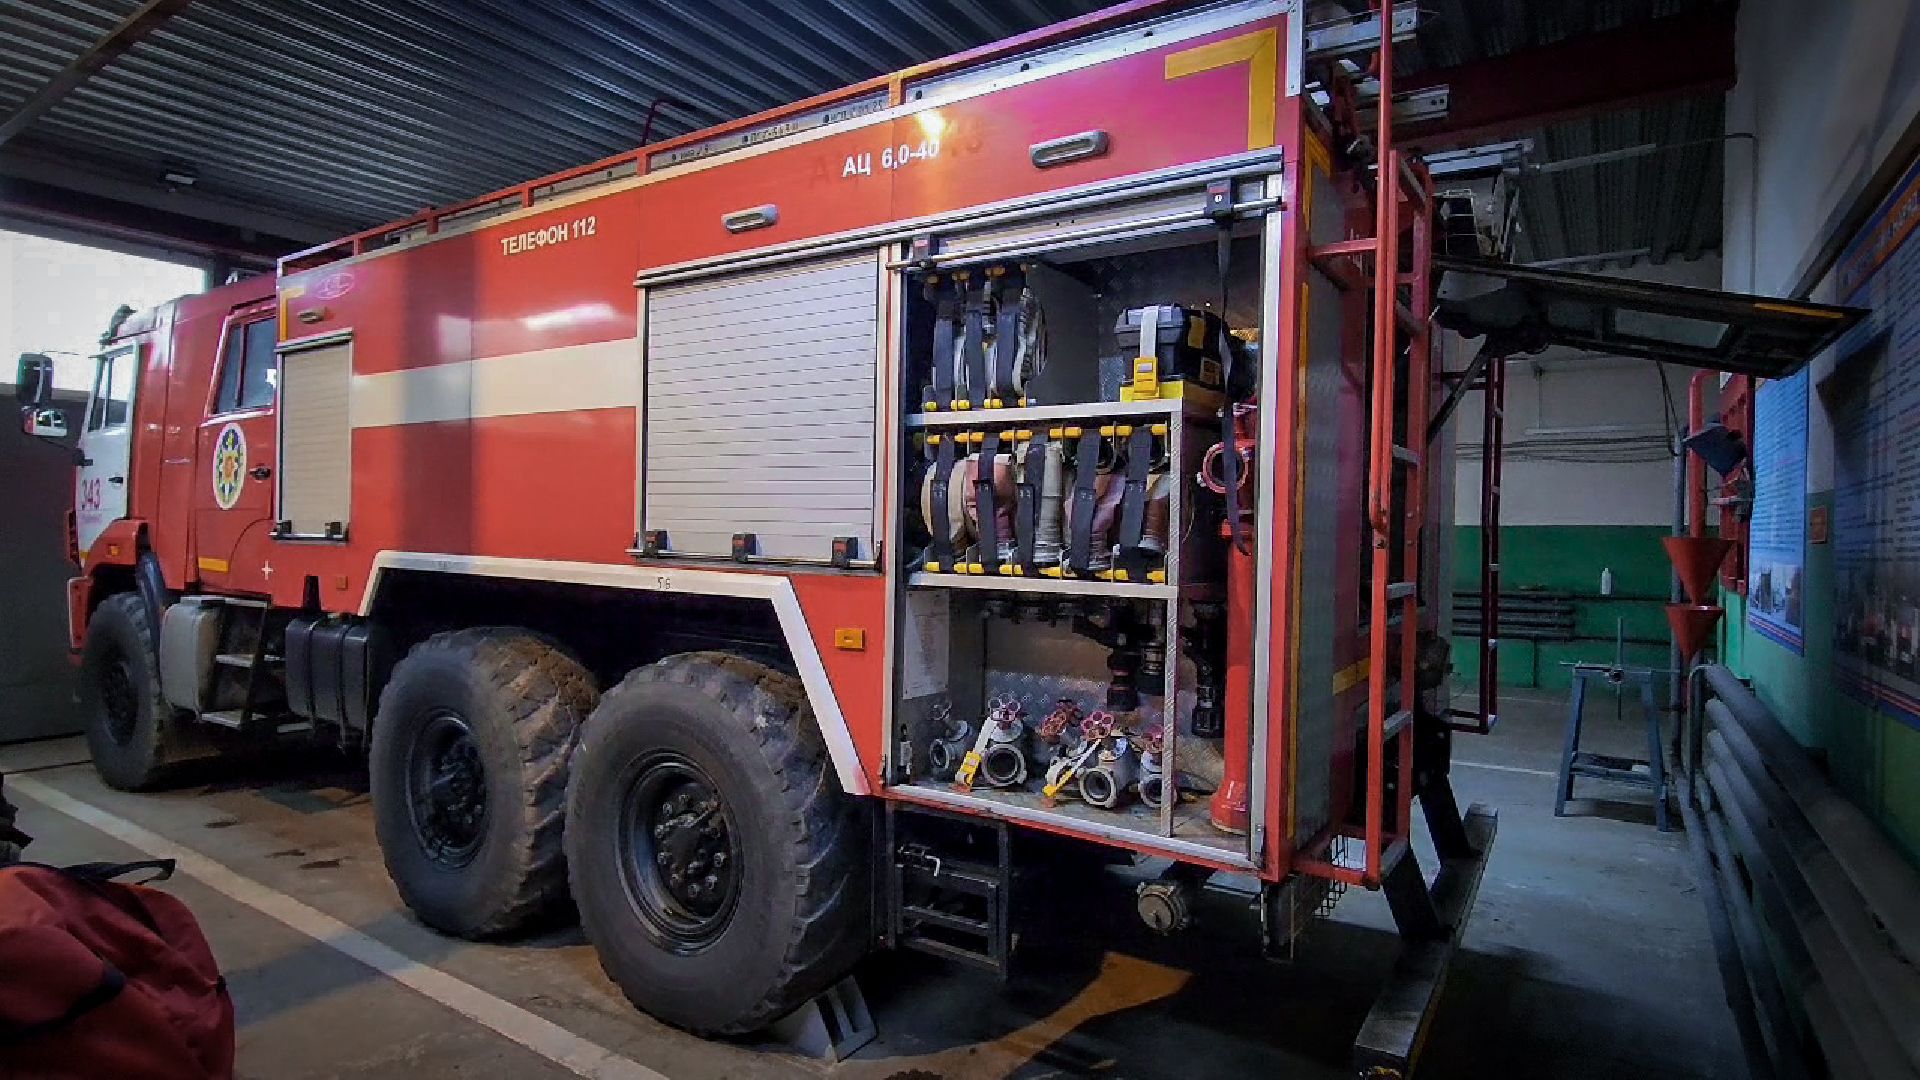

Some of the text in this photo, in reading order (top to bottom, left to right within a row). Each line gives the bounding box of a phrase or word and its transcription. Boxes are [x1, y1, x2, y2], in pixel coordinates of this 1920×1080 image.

[841, 139, 940, 178] АЦ 6,0-40
[500, 215, 596, 256] ТЕЛЕФОН 112
[81, 478, 101, 510] 343
